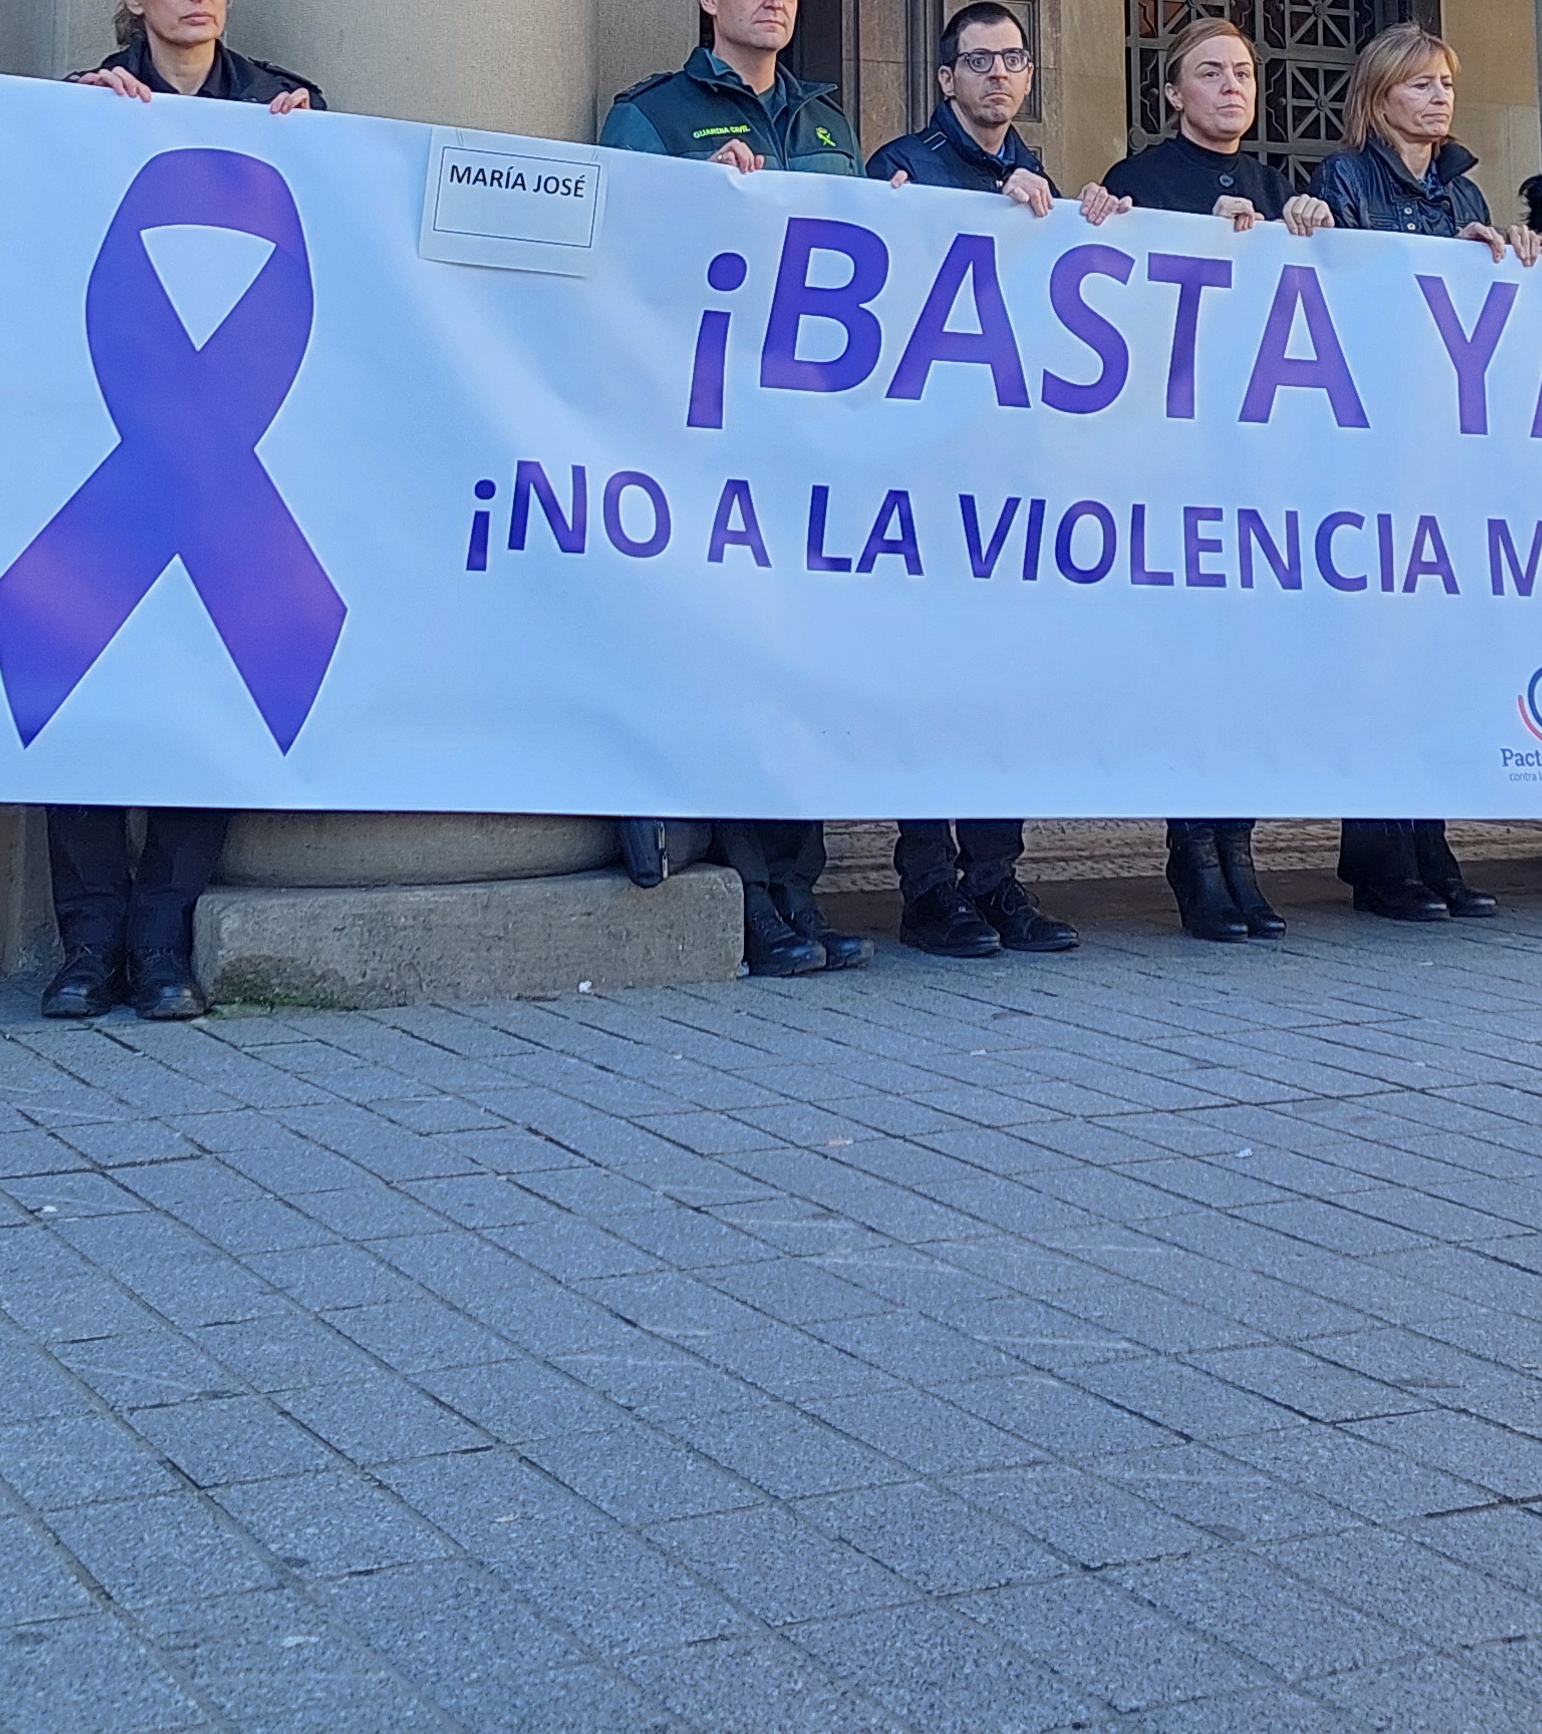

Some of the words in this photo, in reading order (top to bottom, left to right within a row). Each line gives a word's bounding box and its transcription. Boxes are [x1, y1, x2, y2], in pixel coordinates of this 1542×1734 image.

[692, 127, 730, 139] GUARDIA
[449, 164, 526, 192] MARÍA
[533, 174, 586, 198] JOSÉ
[687, 217, 1371, 429] ¡BASTA
[466, 460, 672, 571] ¡NO
[708, 478, 772, 568] A
[807, 484, 925, 576] LA
[958, 494, 1460, 595] VIOLENCIA
[1509, 771, 1537, 781] contra
